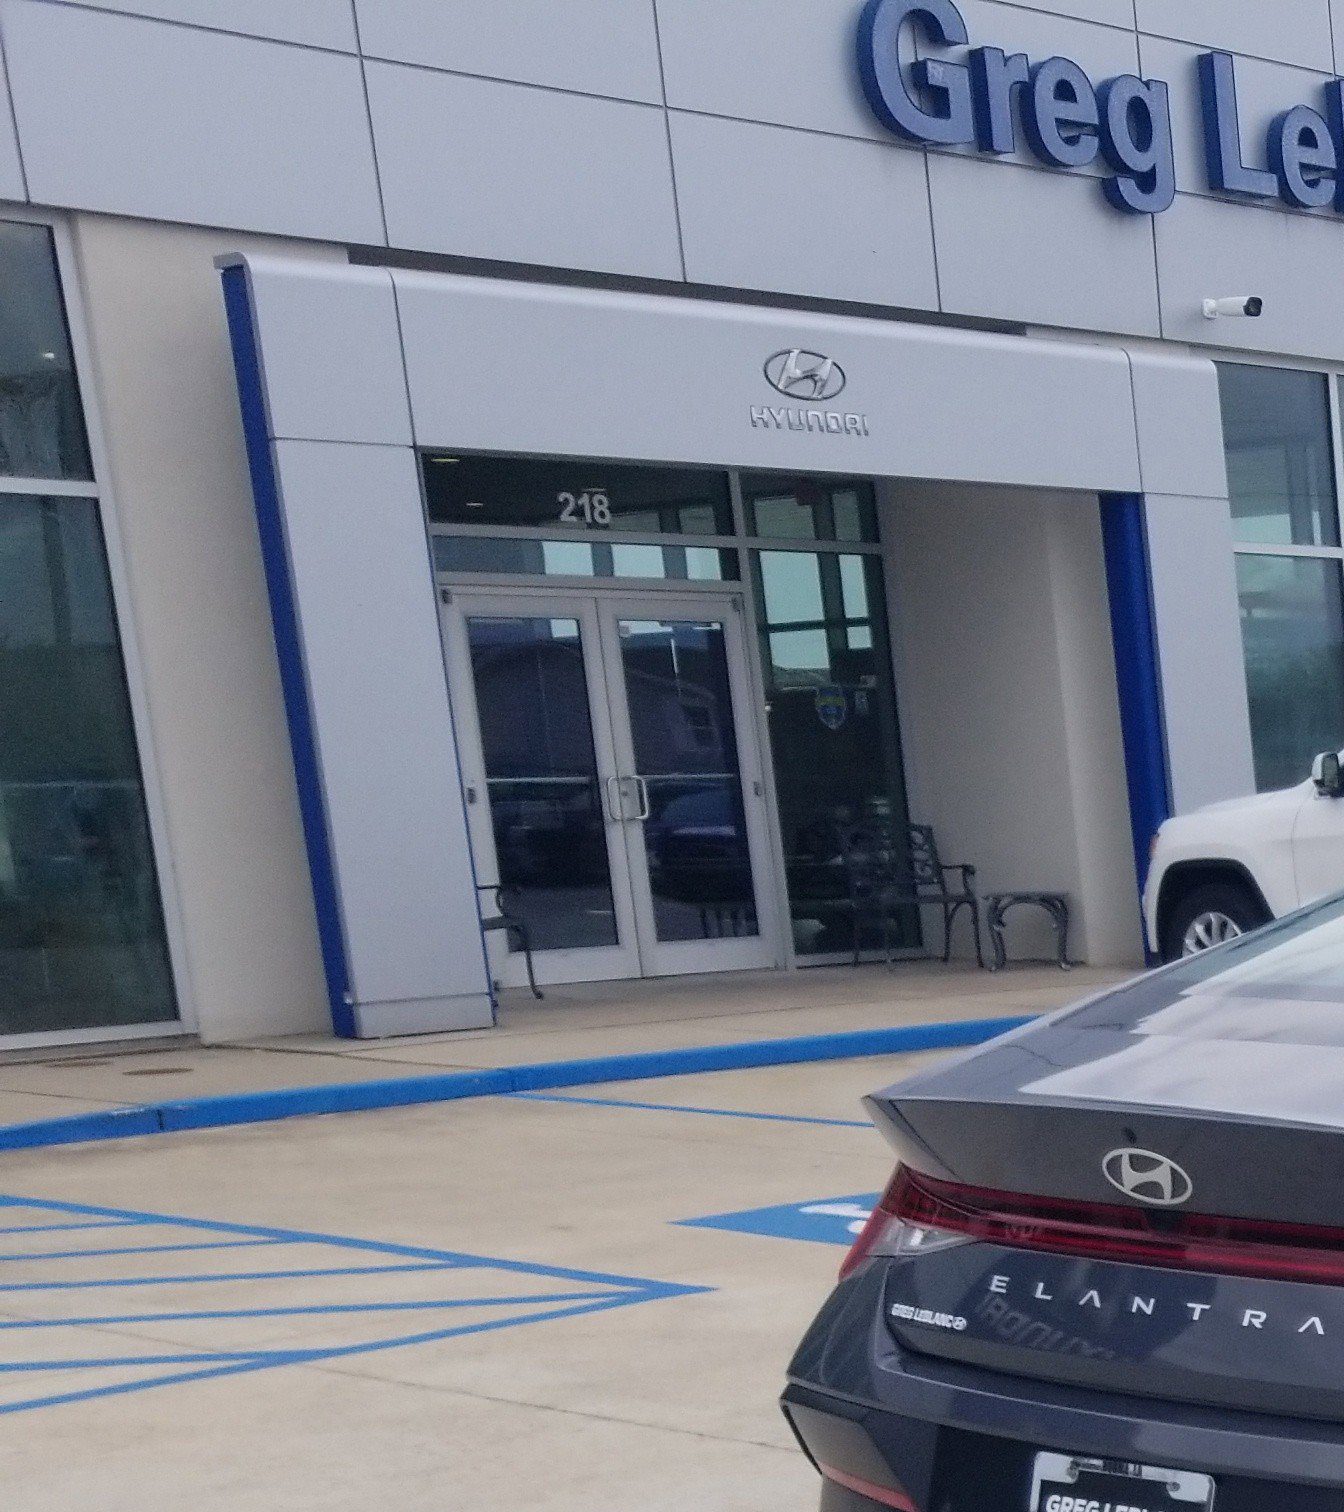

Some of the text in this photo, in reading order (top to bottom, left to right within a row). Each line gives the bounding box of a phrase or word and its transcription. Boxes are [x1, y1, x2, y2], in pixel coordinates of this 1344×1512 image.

[855, 0, 1176, 214] Greg
[749, 404, 869, 437] HYUNDAI
[558, 491, 611, 524] 218
[988, 1274, 1326, 1336] ELANTRA
